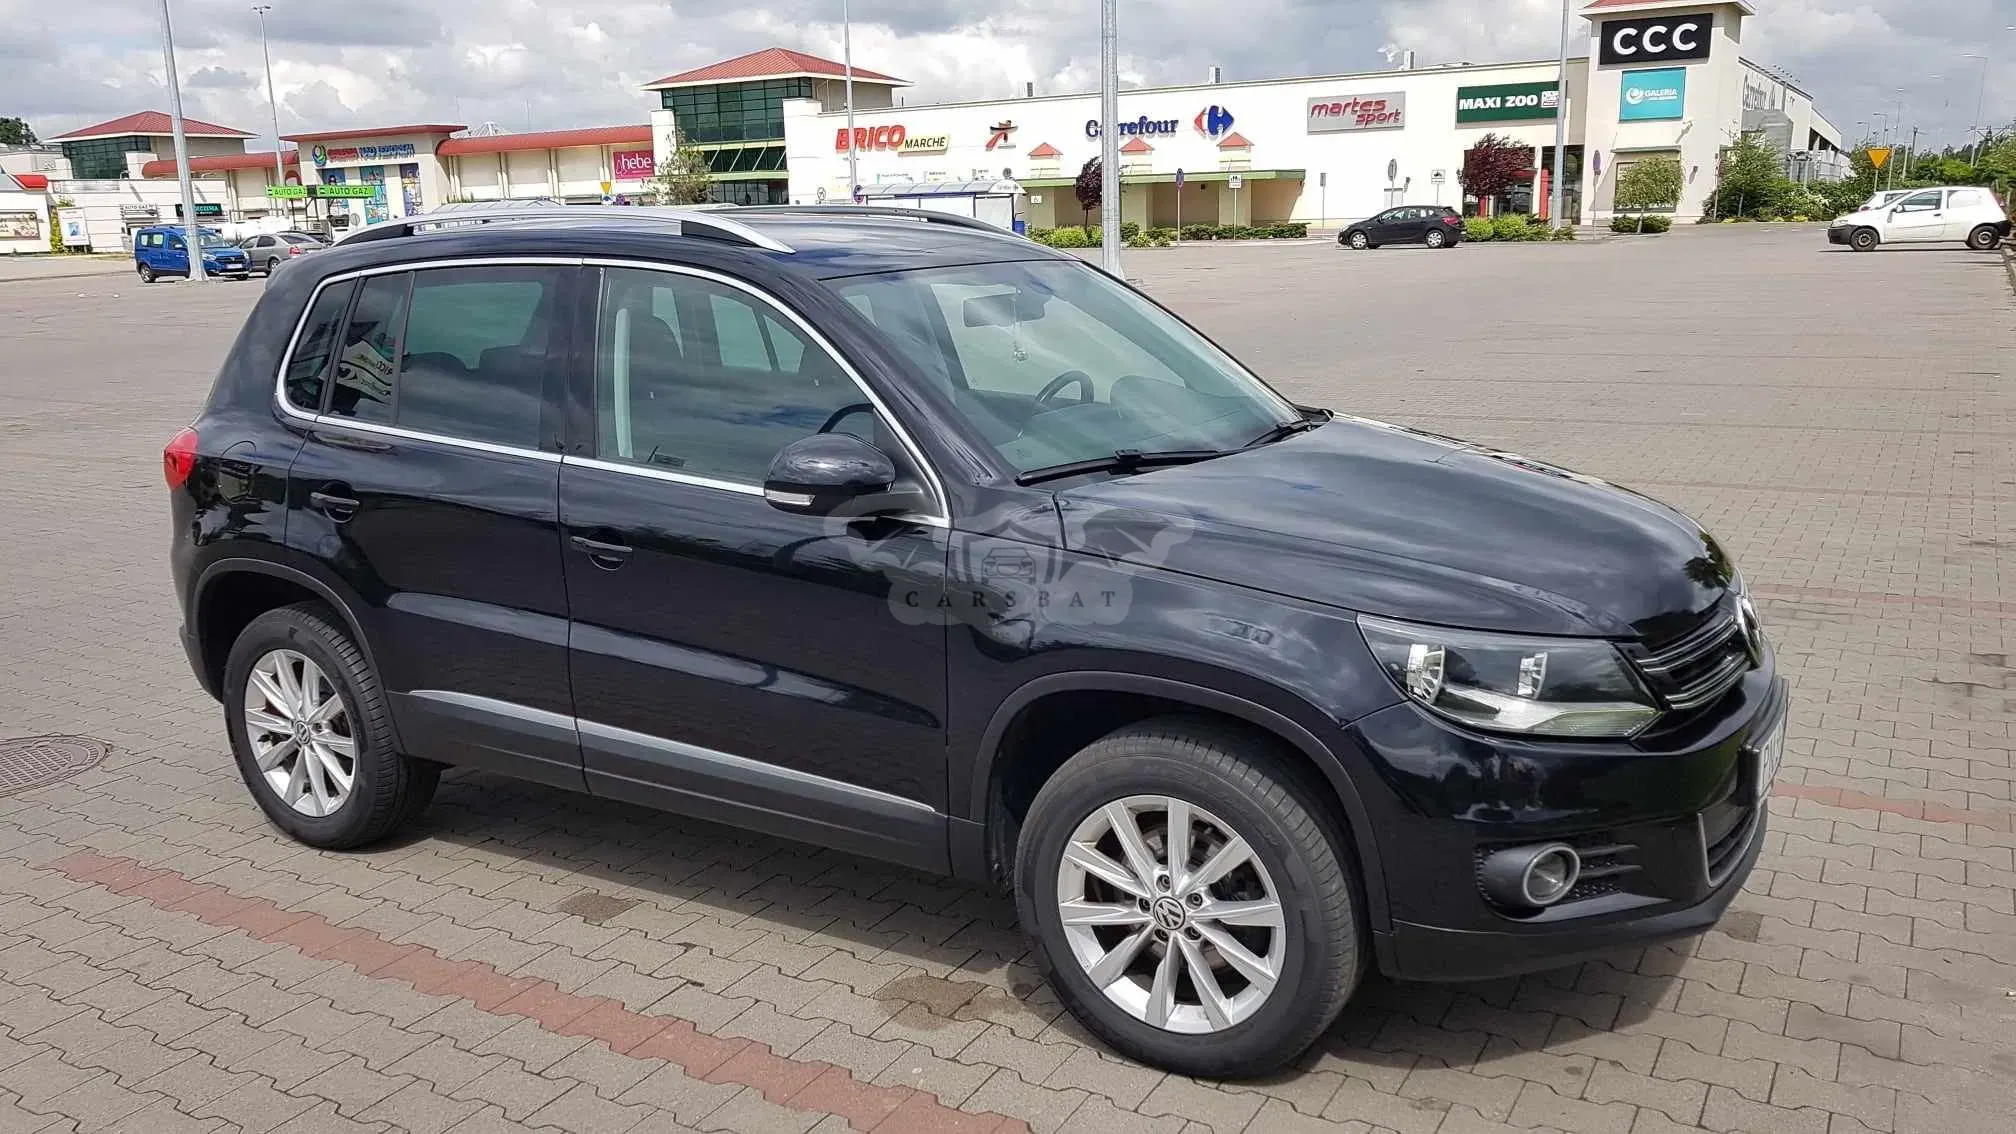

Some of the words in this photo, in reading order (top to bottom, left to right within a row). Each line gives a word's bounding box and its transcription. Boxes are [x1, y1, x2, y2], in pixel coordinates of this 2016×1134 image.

[1613, 23, 1698, 55] CCC
[1644, 88, 1678, 97] GALERIA
[1311, 97, 1387, 118] martes
[1458, 96, 1501, 110] MAXI
[1505, 94, 1538, 107] ZOO
[1085, 115, 1179, 137] Crefour
[1355, 108, 1401, 128] sport
[835, 124, 906, 152] BRICO
[621, 153, 651, 169] hebe
[274, 187, 292, 196] AUTO
[329, 187, 350, 196] AUTO
[352, 187, 369, 195] GAZ
